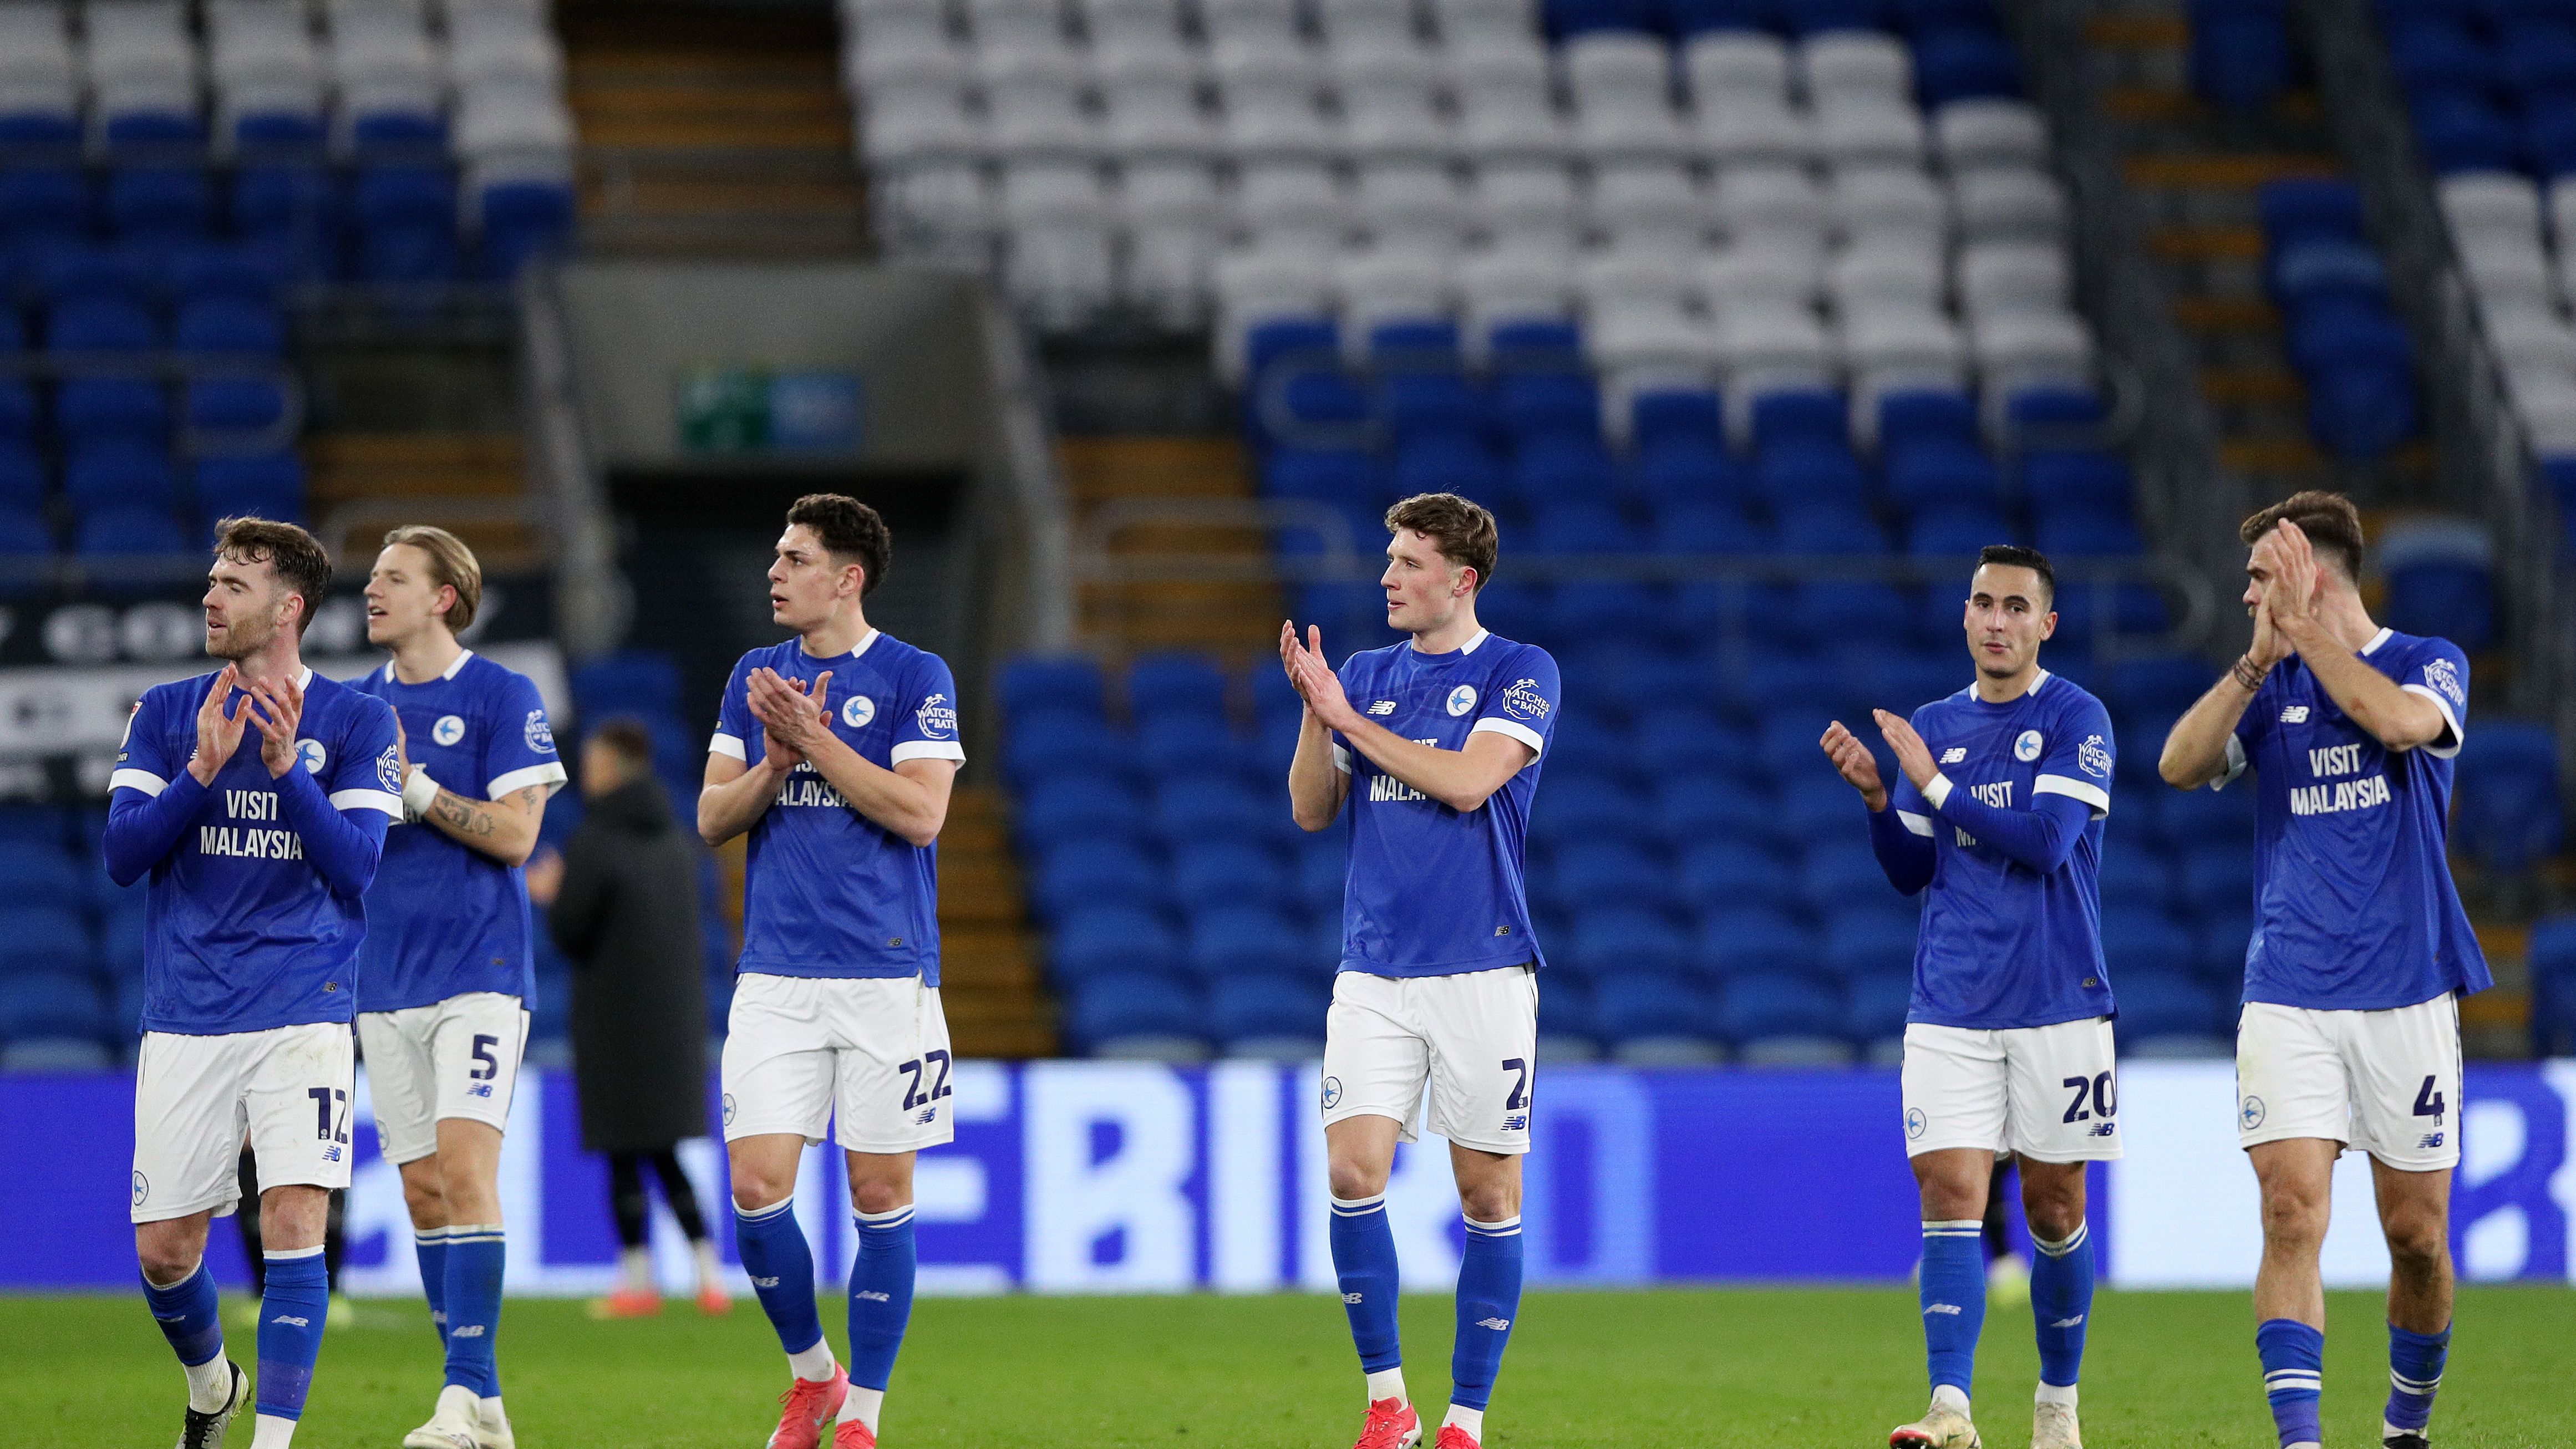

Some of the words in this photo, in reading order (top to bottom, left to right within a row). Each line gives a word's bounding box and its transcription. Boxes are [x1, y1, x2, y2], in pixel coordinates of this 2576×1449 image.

[1503, 689, 1550, 713] WATCHES
[1520, 701, 1546, 719] BATH
[2308, 743, 2360, 777] VISIT
[226, 789, 278, 821] VISIT
[1970, 781, 2013, 808] VISIT
[2290, 774, 2391, 816] MALAYSIA
[200, 825, 303, 861] MALAYSIA
[470, 1034, 499, 1081] 5
[898, 1049, 952, 1112] 22
[1502, 1057, 1528, 1111] 2
[2062, 1071, 2118, 1123] 20
[2413, 1074, 2445, 1126] 4
[307, 1087, 348, 1145] 12
